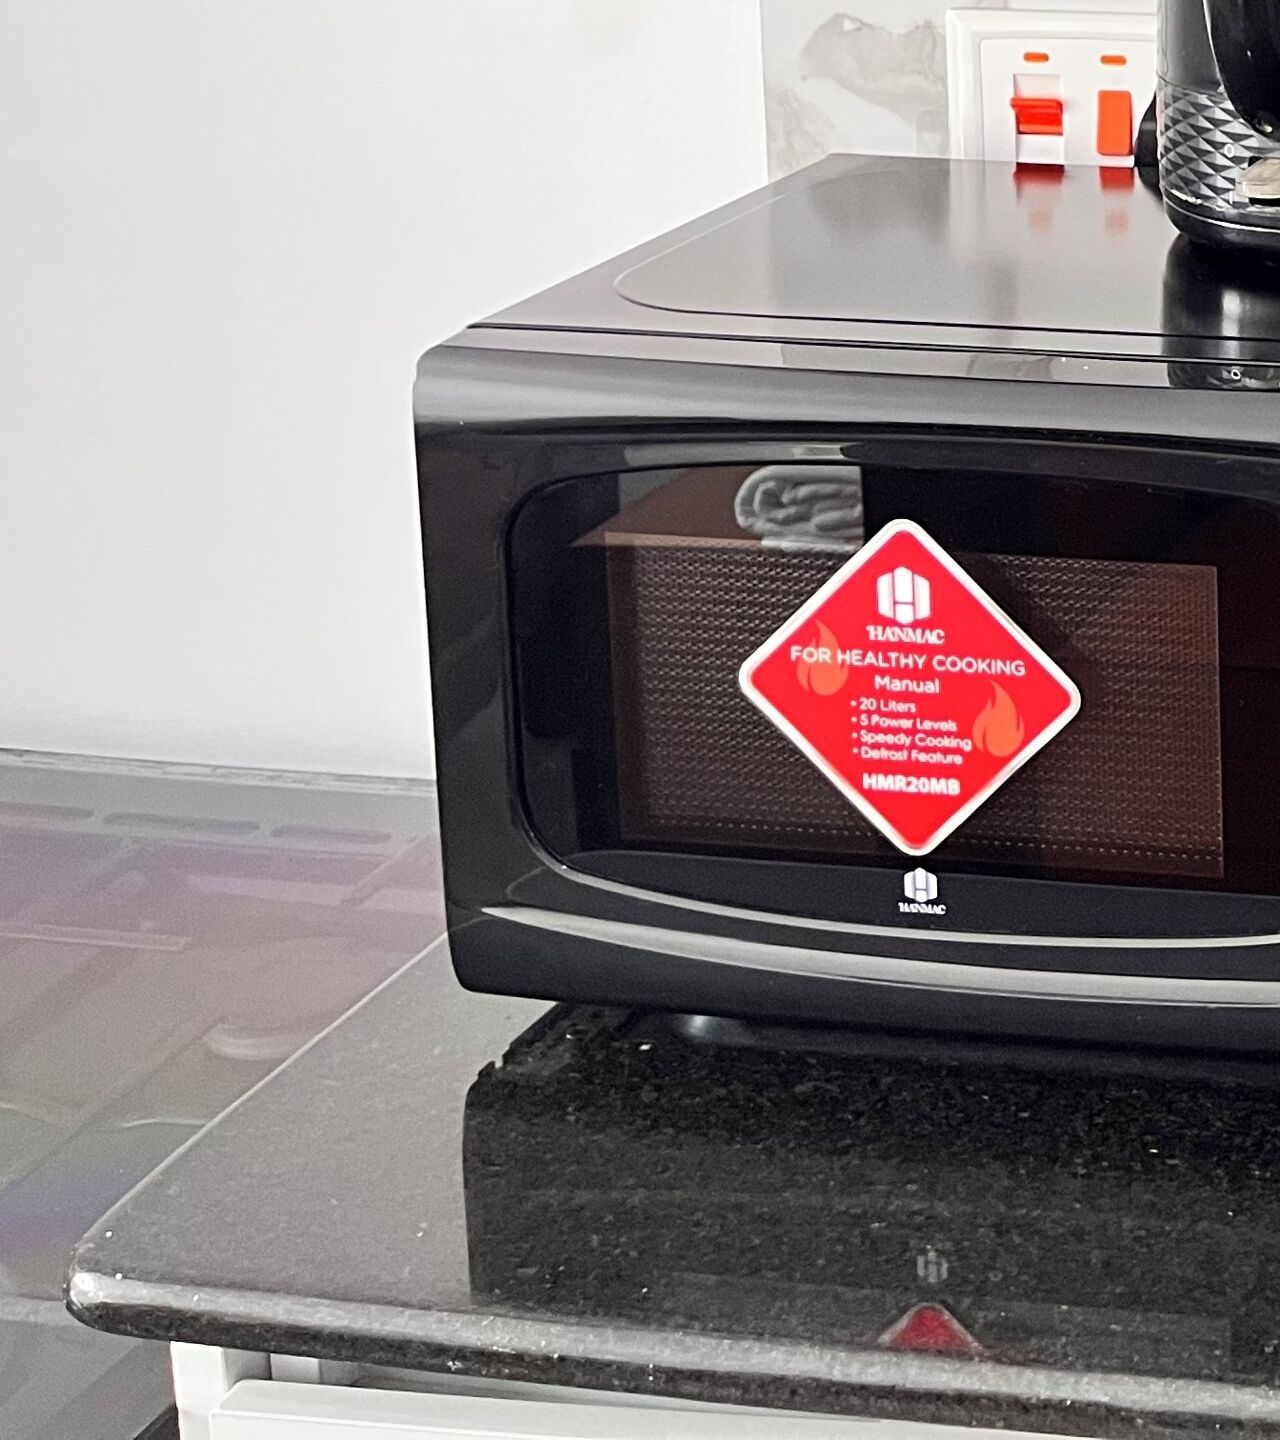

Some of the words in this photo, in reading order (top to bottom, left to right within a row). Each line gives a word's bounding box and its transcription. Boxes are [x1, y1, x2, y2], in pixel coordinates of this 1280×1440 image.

[866, 625, 945, 645] HANMAC
[790, 645, 831, 664] FOR
[837, 649, 927, 669] HEALTHY
[932, 655, 1026, 677] COOKING
[874, 674, 940, 694] Manual
[860, 697, 877, 711] 20
[879, 699, 917, 713] Liters
[860, 713, 869, 727] 5
[871, 714, 914, 729] Power
[916, 718, 958, 732] Levels
[860, 729, 912, 747] Speedy
[914, 733, 973, 752] Cooking
[860, 746, 908, 761] Defrost
[911, 749, 963, 765] Feature
[862, 773, 961, 796] HMR20MB
